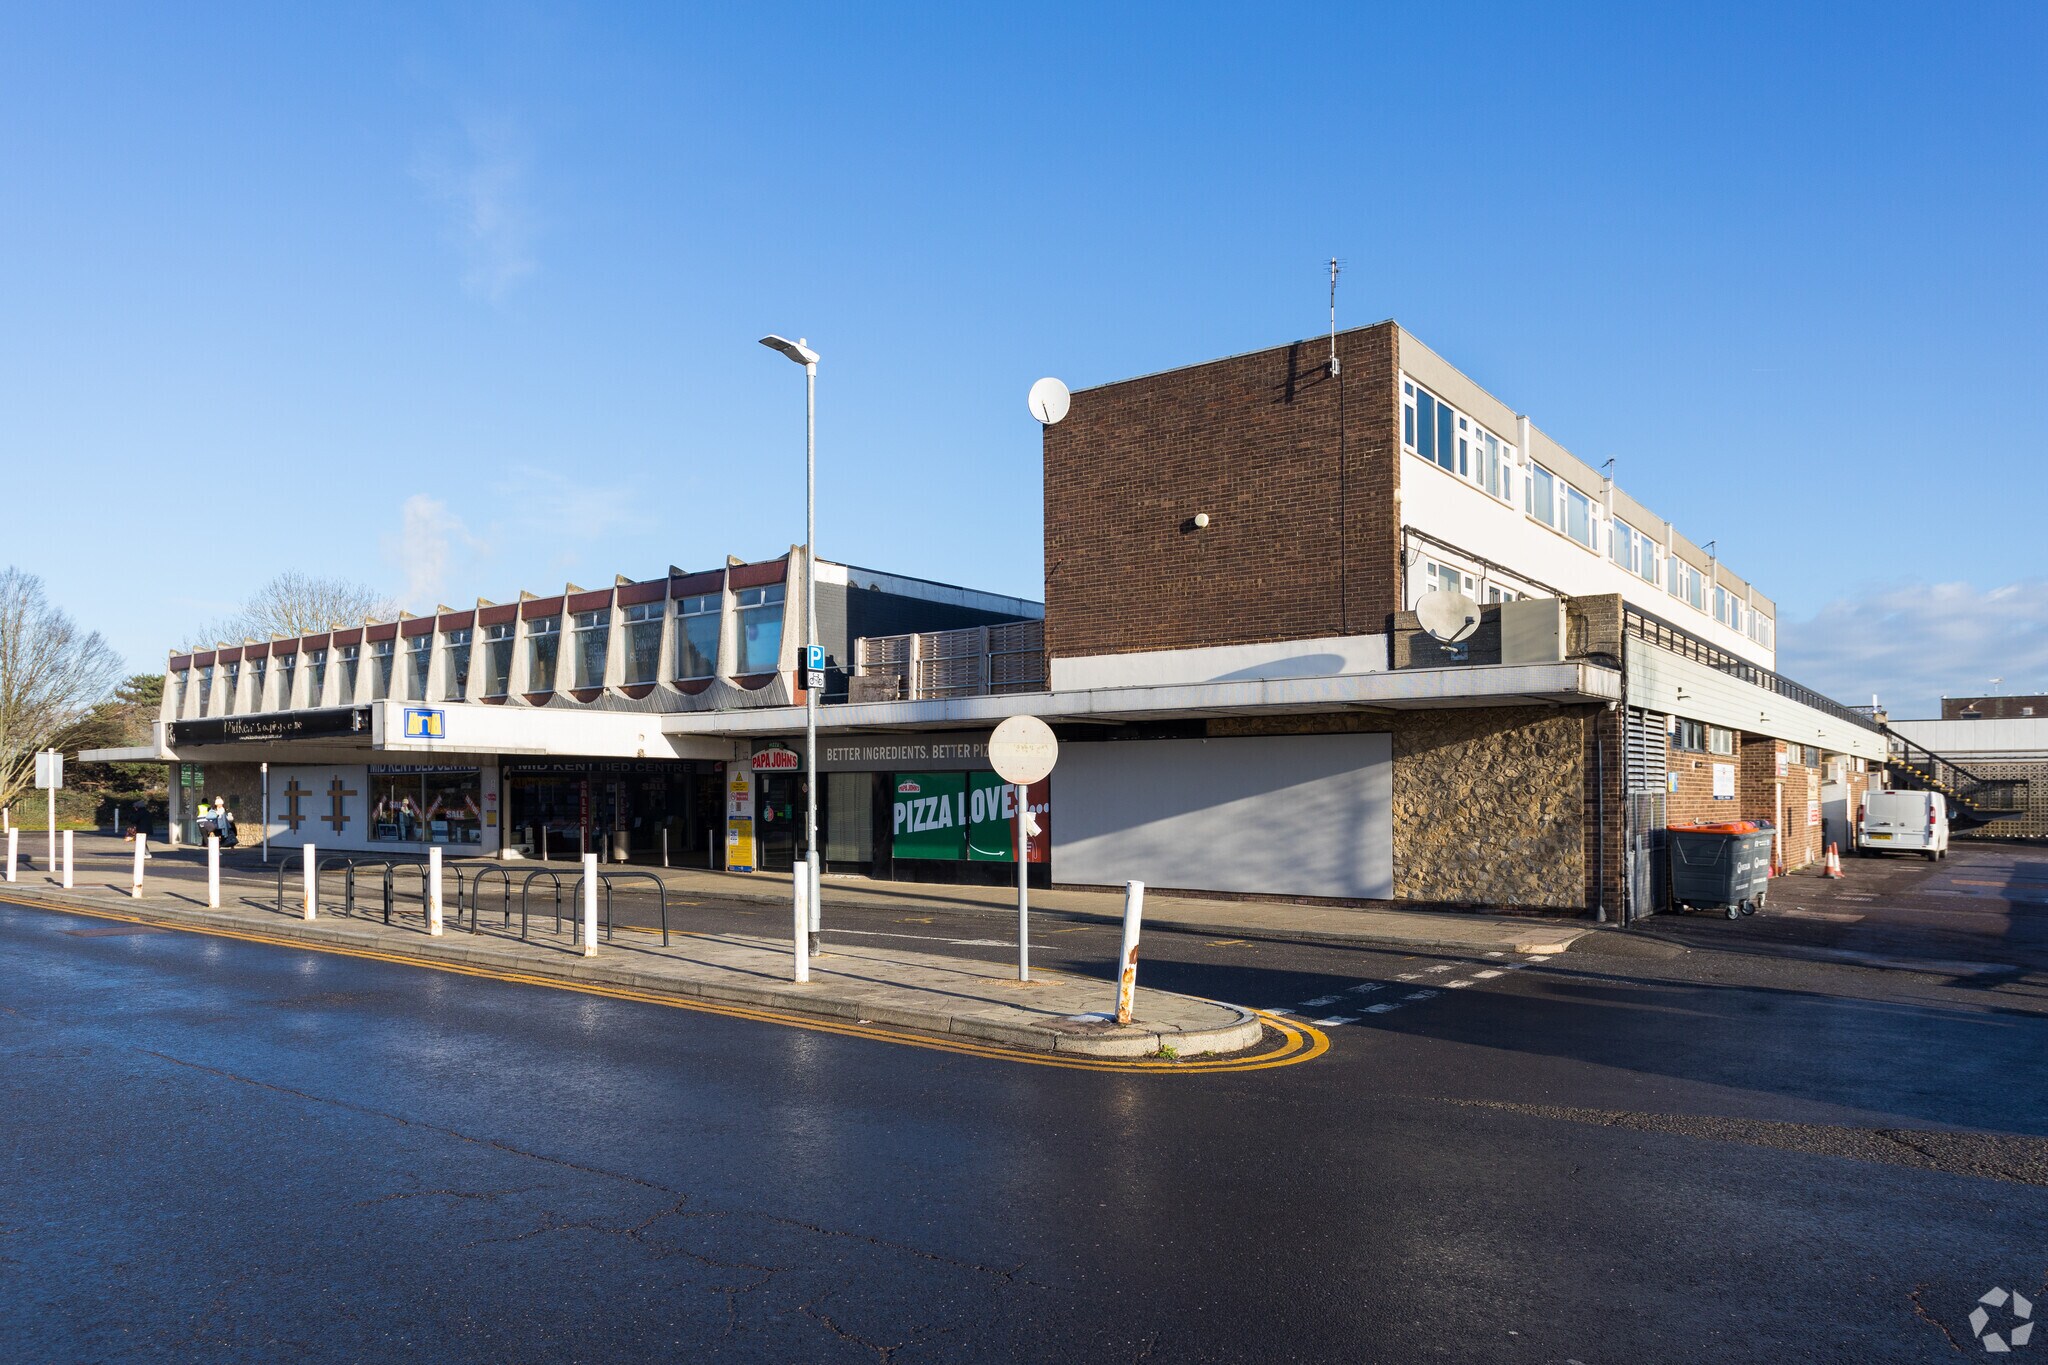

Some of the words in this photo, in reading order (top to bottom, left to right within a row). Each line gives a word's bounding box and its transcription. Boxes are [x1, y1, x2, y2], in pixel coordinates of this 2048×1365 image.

[809, 650, 822, 667] P
[752, 752, 770, 768] PAPA
[827, 747, 861, 761] BETTER
[863, 745, 929, 760] INGREDIENTS.
[932, 743, 971, 759] BETTER
[635, 763, 692, 773] CENTRE
[446, 810, 465, 818] SALE
[894, 794, 953, 835] PIZZA
